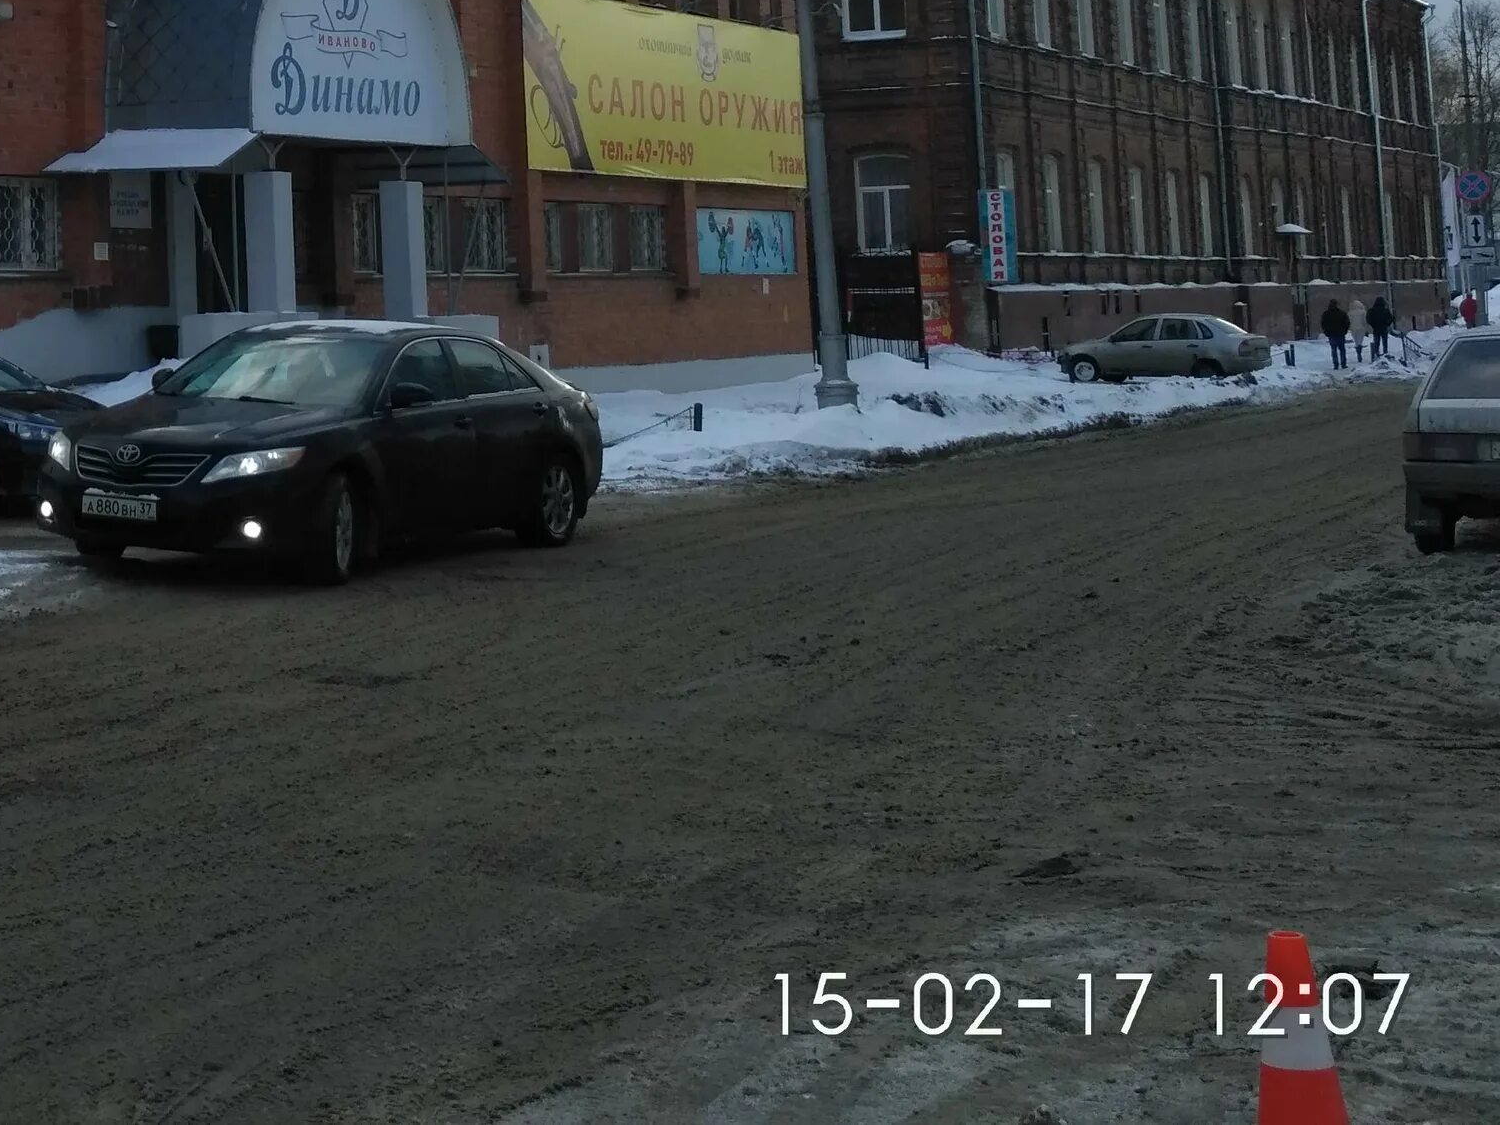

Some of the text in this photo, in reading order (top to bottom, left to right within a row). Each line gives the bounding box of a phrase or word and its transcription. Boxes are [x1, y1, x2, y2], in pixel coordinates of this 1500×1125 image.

[318, 33, 376, 52] ИВАНОВО
[270, 42, 421, 117] Динамо
[588, 74, 804, 136] САЛОН ОРУЖИЯ
[600, 137, 694, 166] тел.: 49-79-89
[777, 155, 805, 176] этаж
[990, 192, 1005, 280] СТОЛОВАЯ
